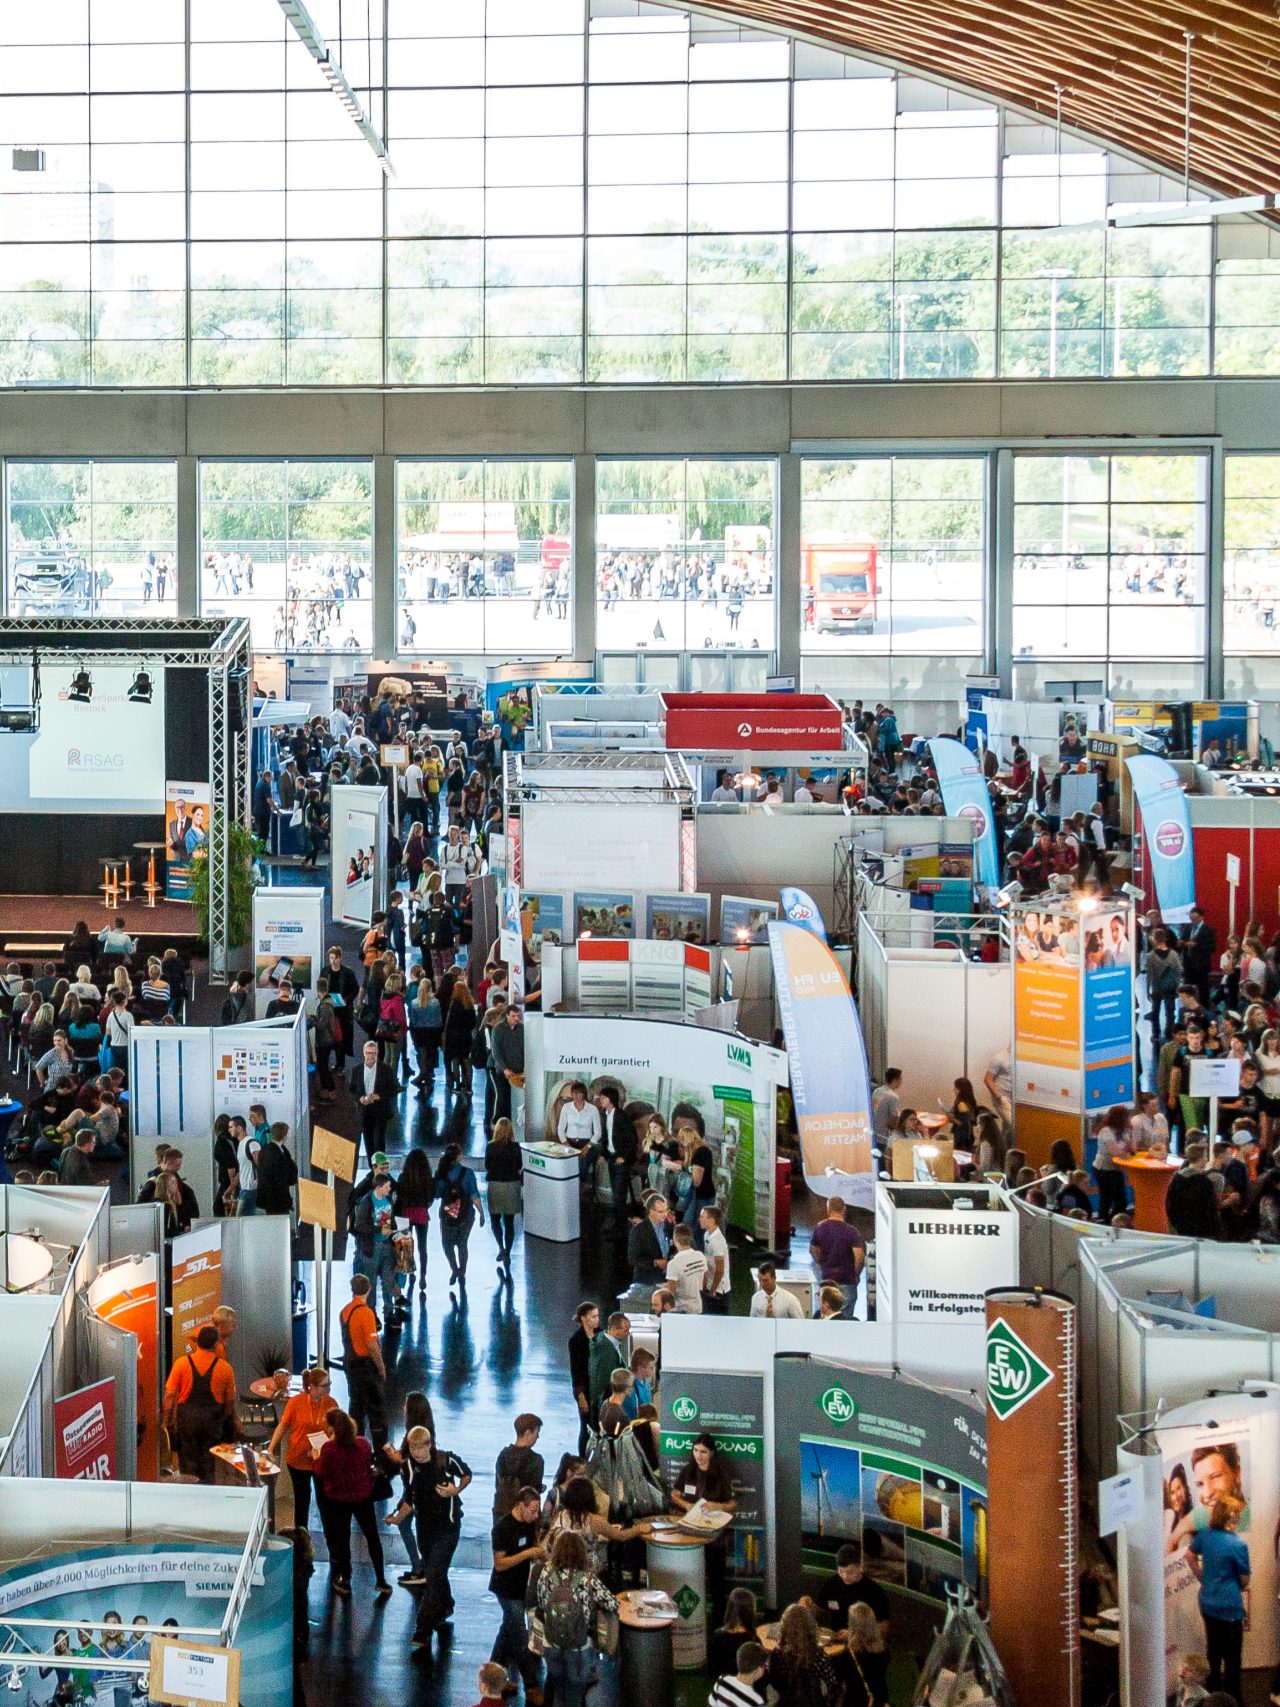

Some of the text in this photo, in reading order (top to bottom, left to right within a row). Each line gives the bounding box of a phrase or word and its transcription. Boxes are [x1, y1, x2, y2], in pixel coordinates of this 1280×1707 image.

[74, 704, 107, 713] Rostock
[755, 726, 841, 735] Bundesagentur für Arbeit
[84, 754, 125, 767] RSAG
[727, 1043, 745, 1064] LVM
[559, 1054, 651, 1068] Zukunft garantiert
[908, 1222, 1000, 1237] LIEBHERR
[908, 1289, 984, 1300] Willkommen
[908, 1302, 924, 1312] im
[66, 1409, 102, 1442] Ostseewelle
[82, 1423, 104, 1443] RADIO
[665, 1436, 757, 1455] AUSDUNG
[6, 1584, 31, 1605] haben
[33, 1576, 55, 1597] über
[56, 1570, 83, 1587] 2.000
[84, 1561, 158, 1582] Möglichkeiten
[160, 1561, 178, 1574] für
[180, 1560, 211, 1573] deine
[195, 1582, 234, 1591] SIEMEN
[187, 1666, 204, 1676] 353
